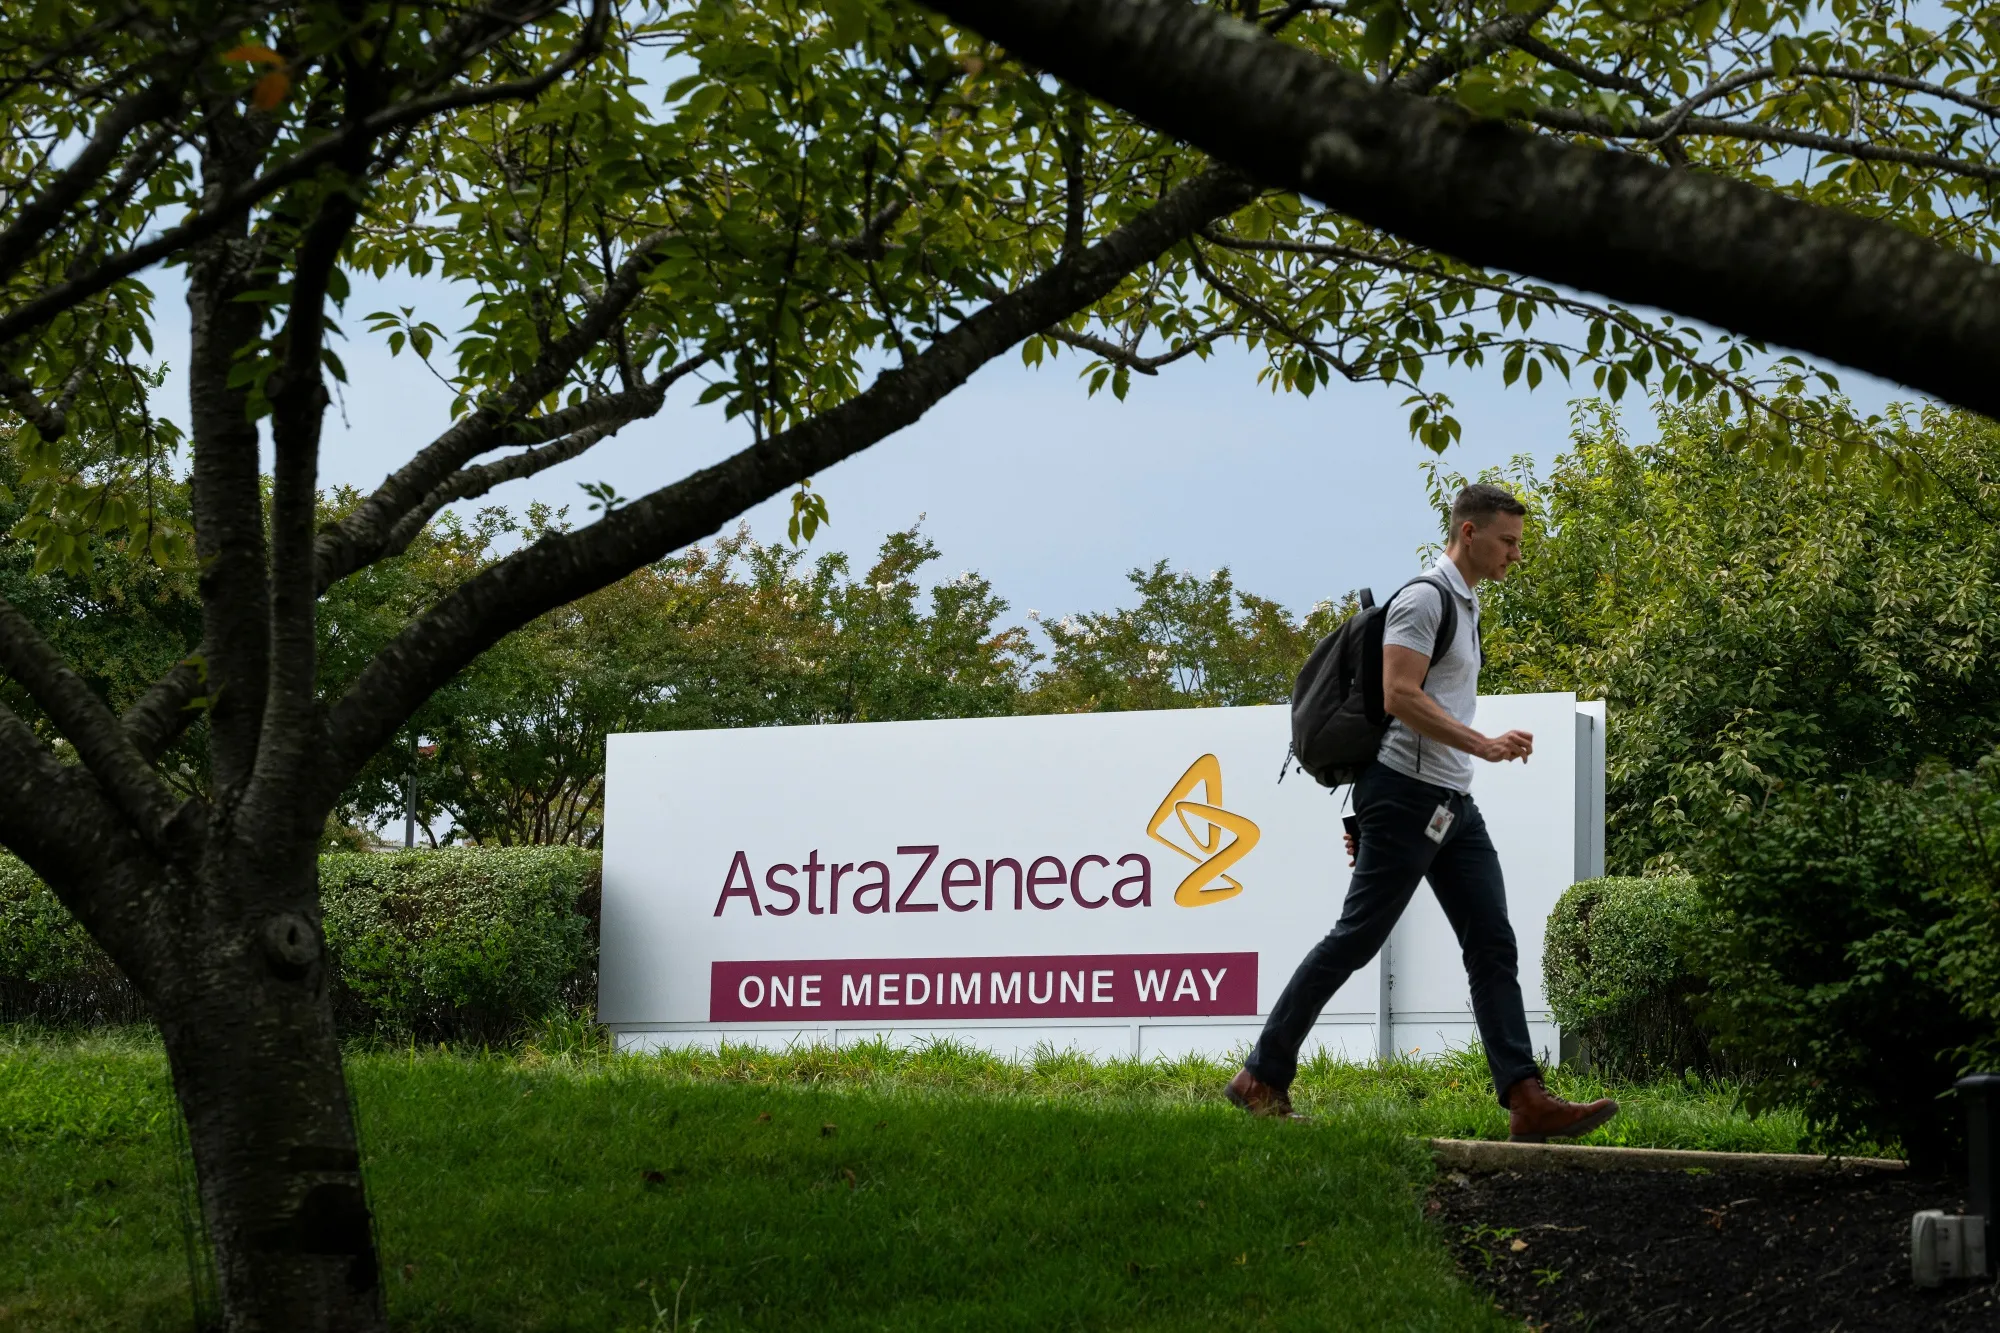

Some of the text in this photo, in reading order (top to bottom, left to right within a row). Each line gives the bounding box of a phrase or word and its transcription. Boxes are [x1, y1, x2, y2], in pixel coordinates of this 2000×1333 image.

[713, 845, 1151, 917] AstraZeneca
[738, 967, 1228, 1009] ONE MEDIMMUNE WAY
